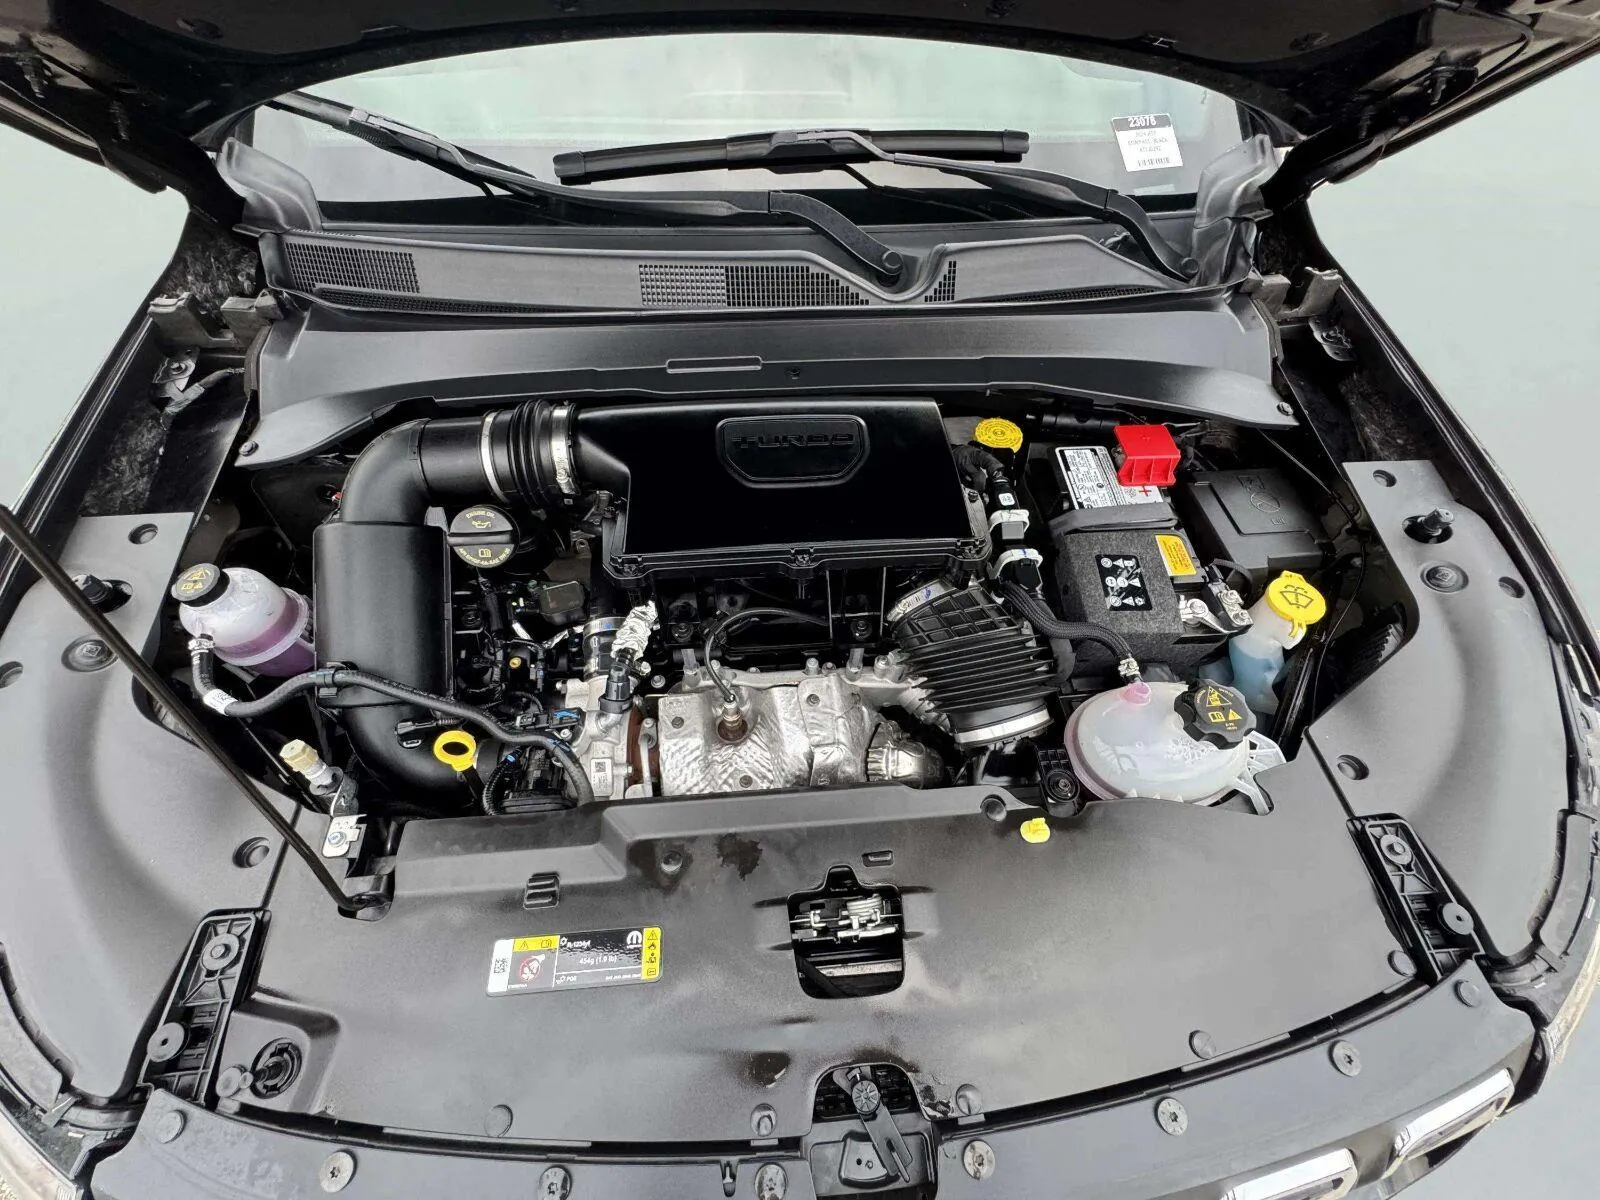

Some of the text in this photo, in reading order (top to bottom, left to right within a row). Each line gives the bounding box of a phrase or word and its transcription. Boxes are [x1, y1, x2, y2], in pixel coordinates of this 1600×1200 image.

[732, 433, 854, 448] TURBO
[465, 510, 496, 519] ENGINE OIL
